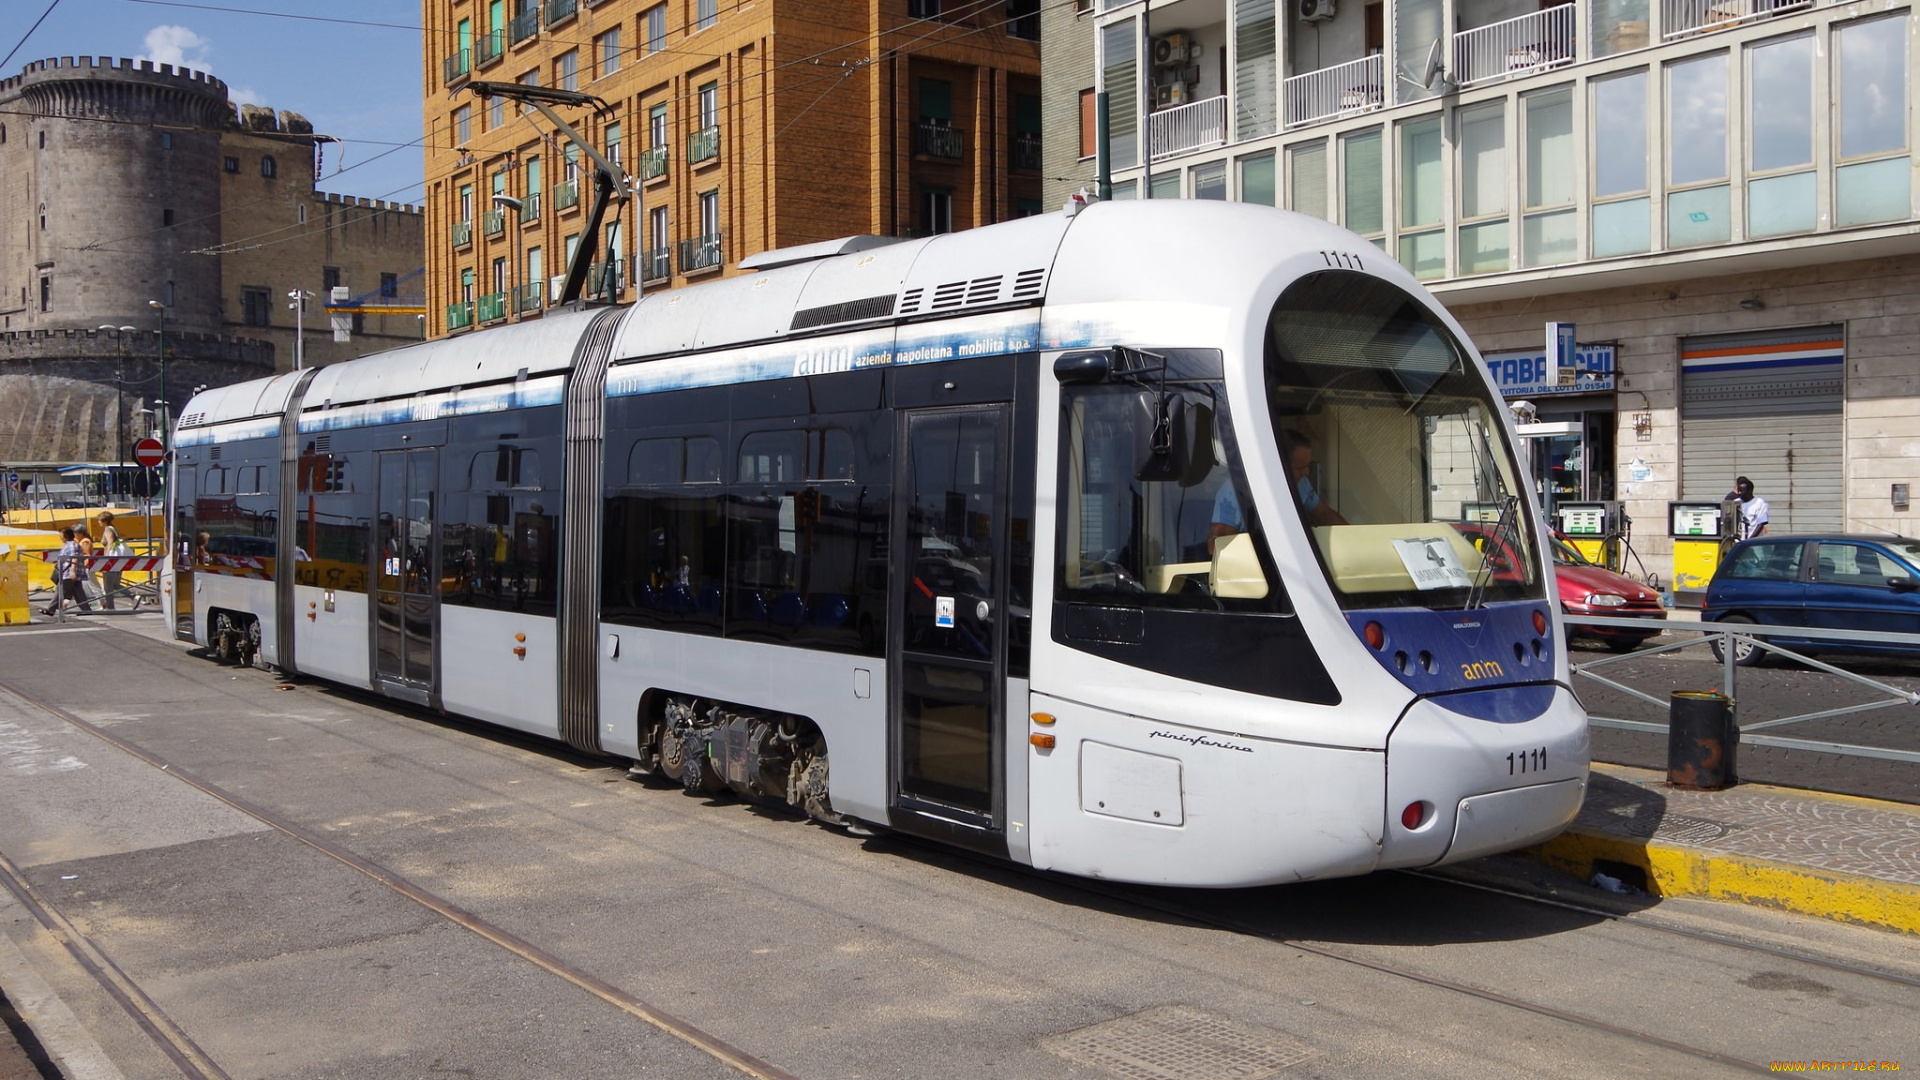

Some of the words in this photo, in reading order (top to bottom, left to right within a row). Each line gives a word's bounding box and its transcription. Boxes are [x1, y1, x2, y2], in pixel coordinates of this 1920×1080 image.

[1320, 250, 1364, 270] 1111
[855, 351, 892, 367] azienda
[896, 345, 953, 364] napoletana
[958, 338, 1004, 356] mobilità
[1009, 339, 1031, 351] s.p.a.
[1487, 352, 1611, 384] TABACHI
[617, 378, 637, 394] 1111
[1426, 544, 1446, 567] 4
[1461, 661, 1504, 680] anm
[1149, 731, 1254, 753] pininfarina
[1506, 746, 1547, 776] 1111
